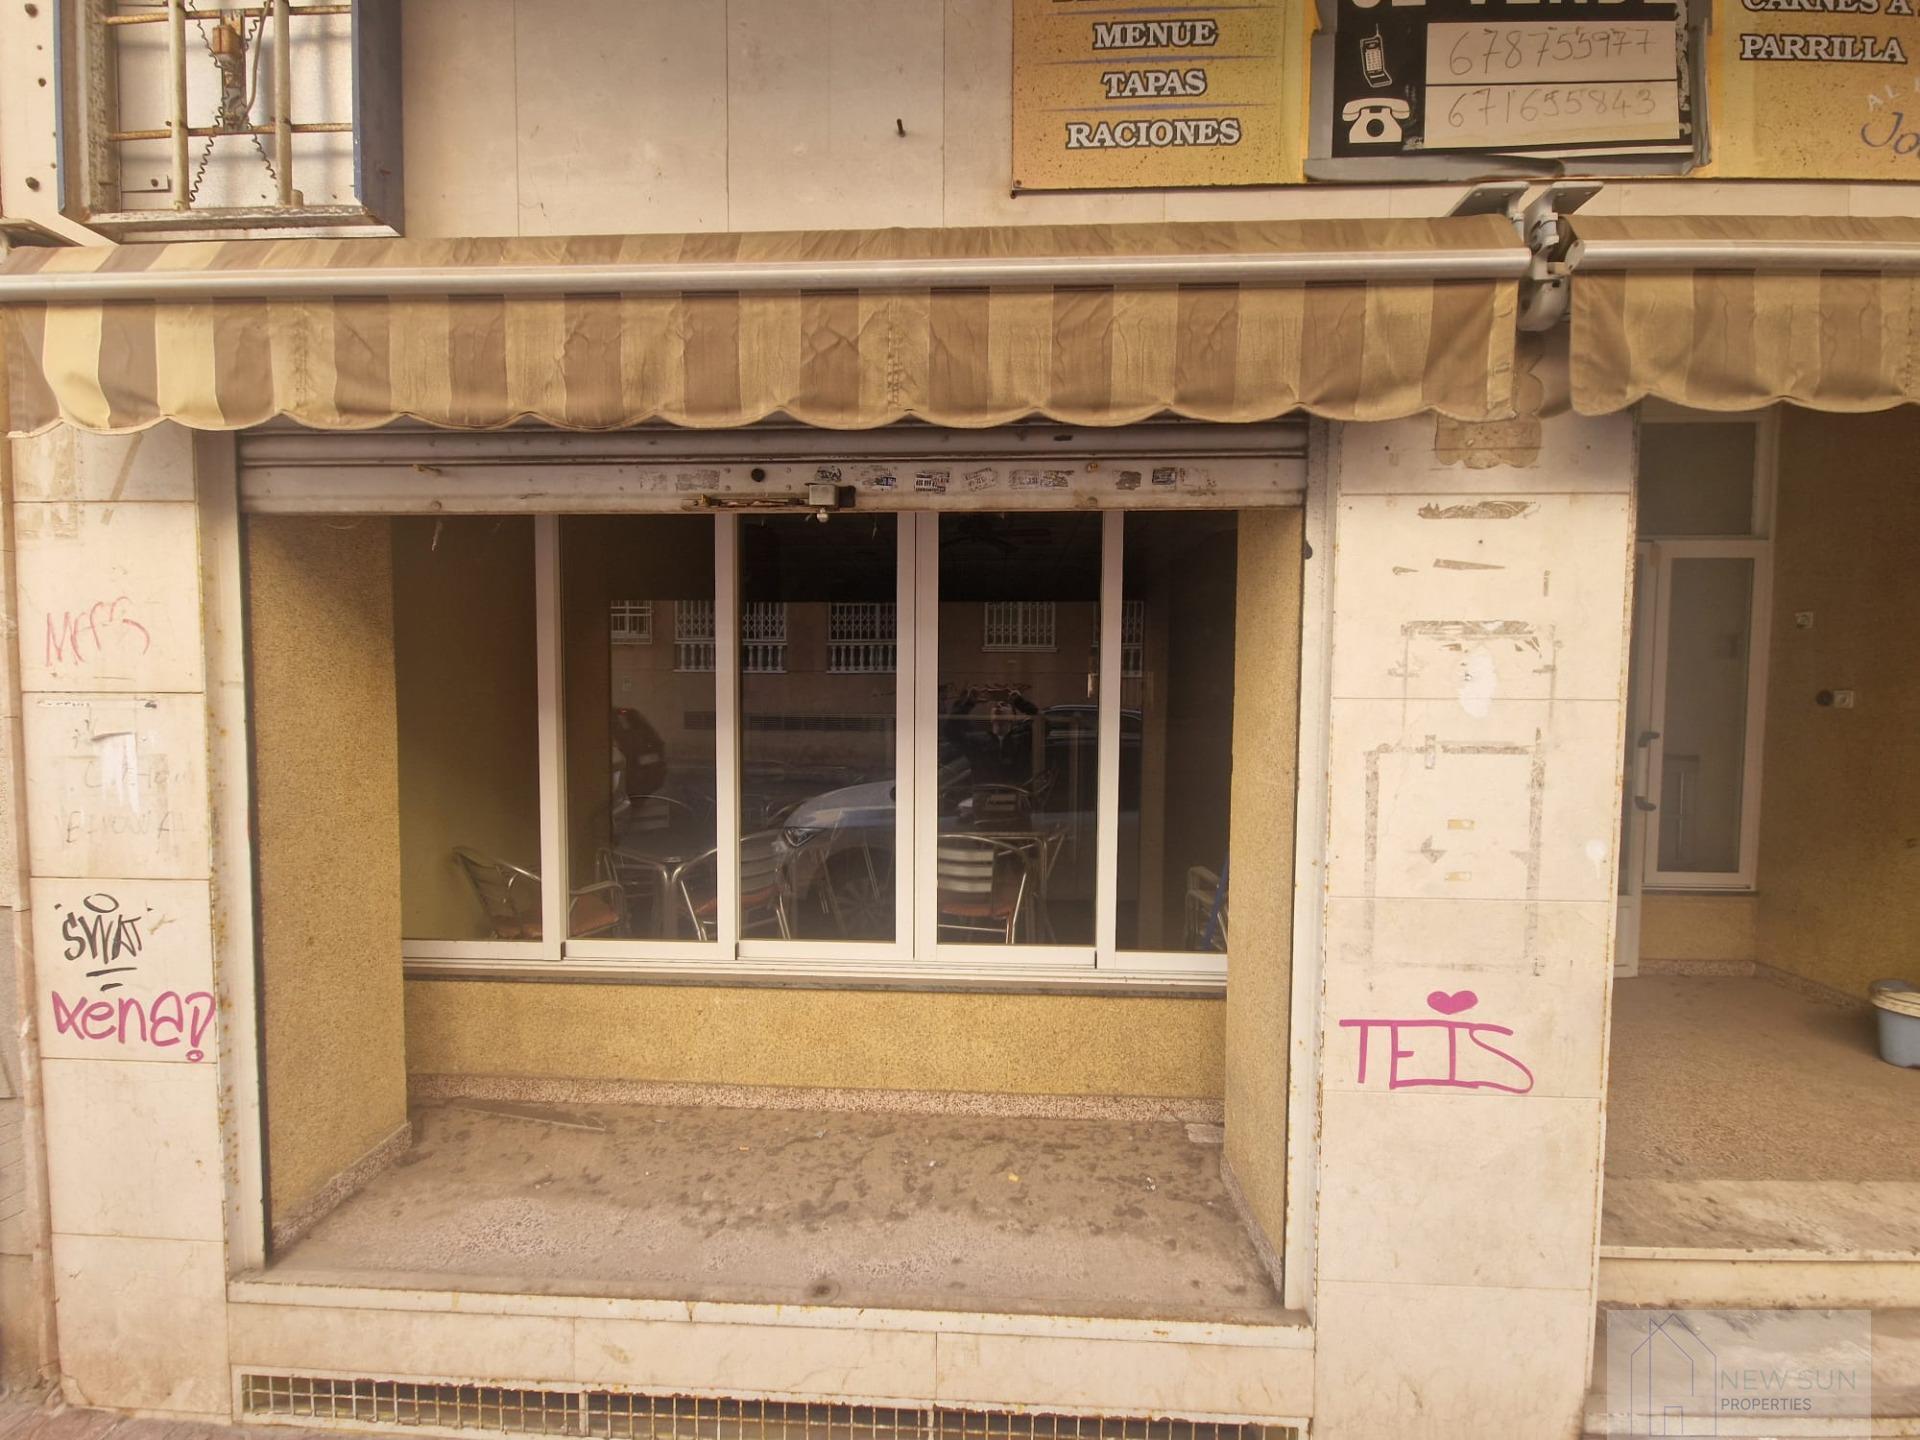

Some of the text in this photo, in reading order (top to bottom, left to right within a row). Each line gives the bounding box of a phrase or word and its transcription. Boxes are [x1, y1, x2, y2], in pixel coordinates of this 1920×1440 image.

[1092, 19, 1219, 50] MENUE
[1740, 34, 1908, 64] PARRILLA
[1102, 69, 1208, 99] TAPAS
[1065, 117, 1242, 149] RACIONES
